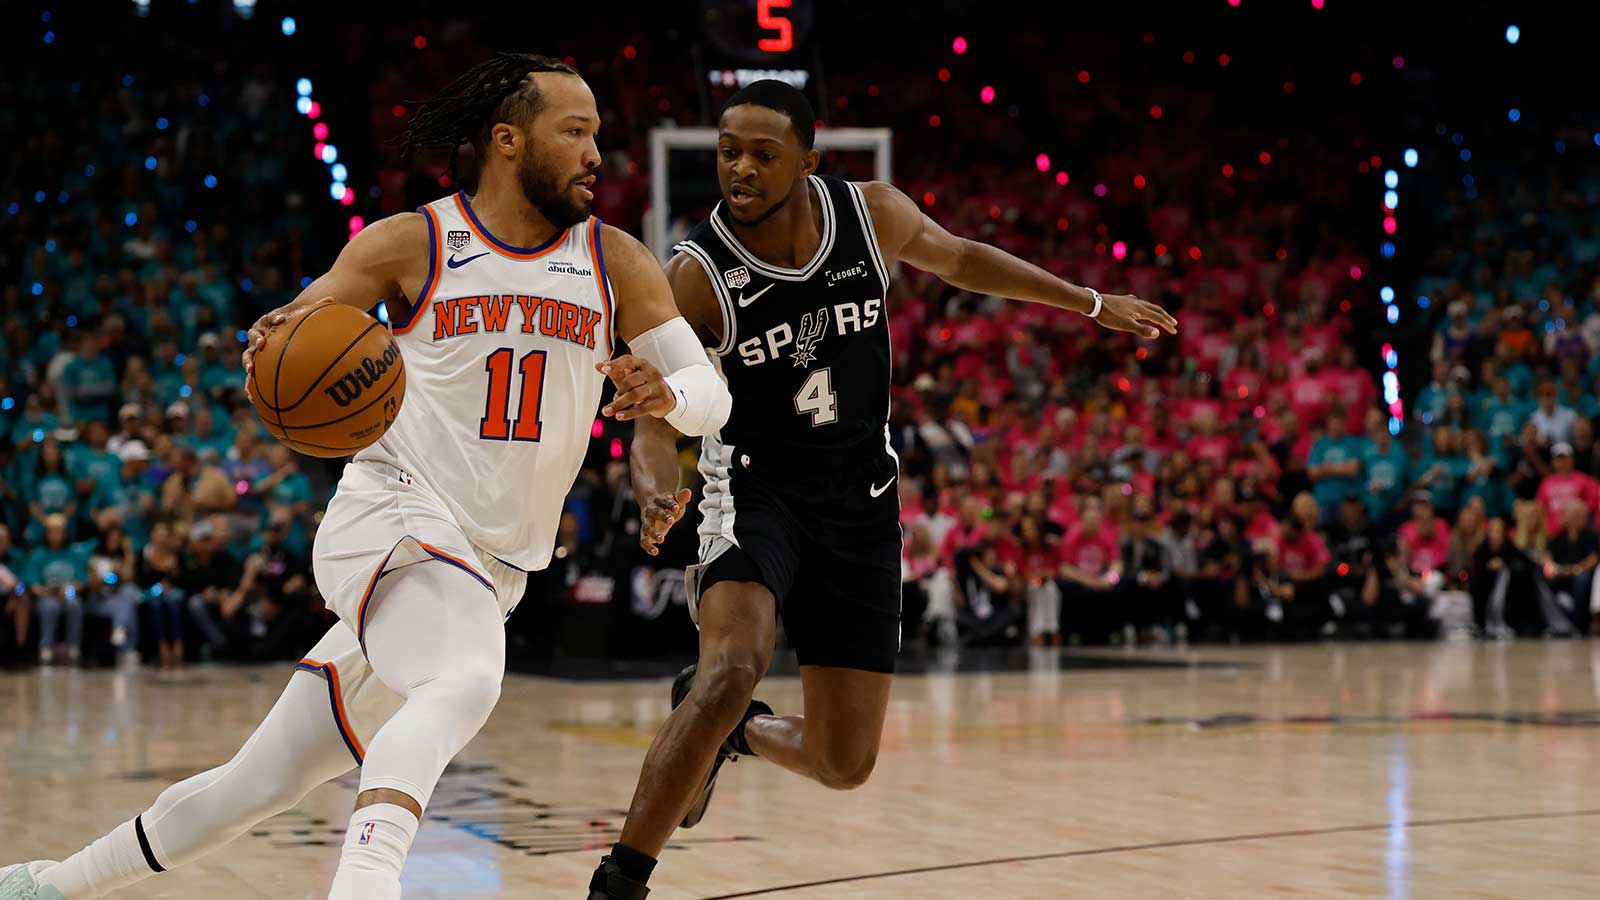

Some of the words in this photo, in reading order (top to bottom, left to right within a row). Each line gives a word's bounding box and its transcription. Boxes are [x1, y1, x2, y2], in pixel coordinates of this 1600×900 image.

[757, 0, 792, 52] 5
[548, 265, 566, 273] abu
[567, 266, 592, 276] dhabi
[831, 266, 862, 282] LEDGER
[433, 295, 513, 342] NEW
[516, 295, 602, 350] YORK
[323, 340, 400, 407] Wilson
[479, 347, 547, 442] 11
[793, 367, 838, 427] 4
